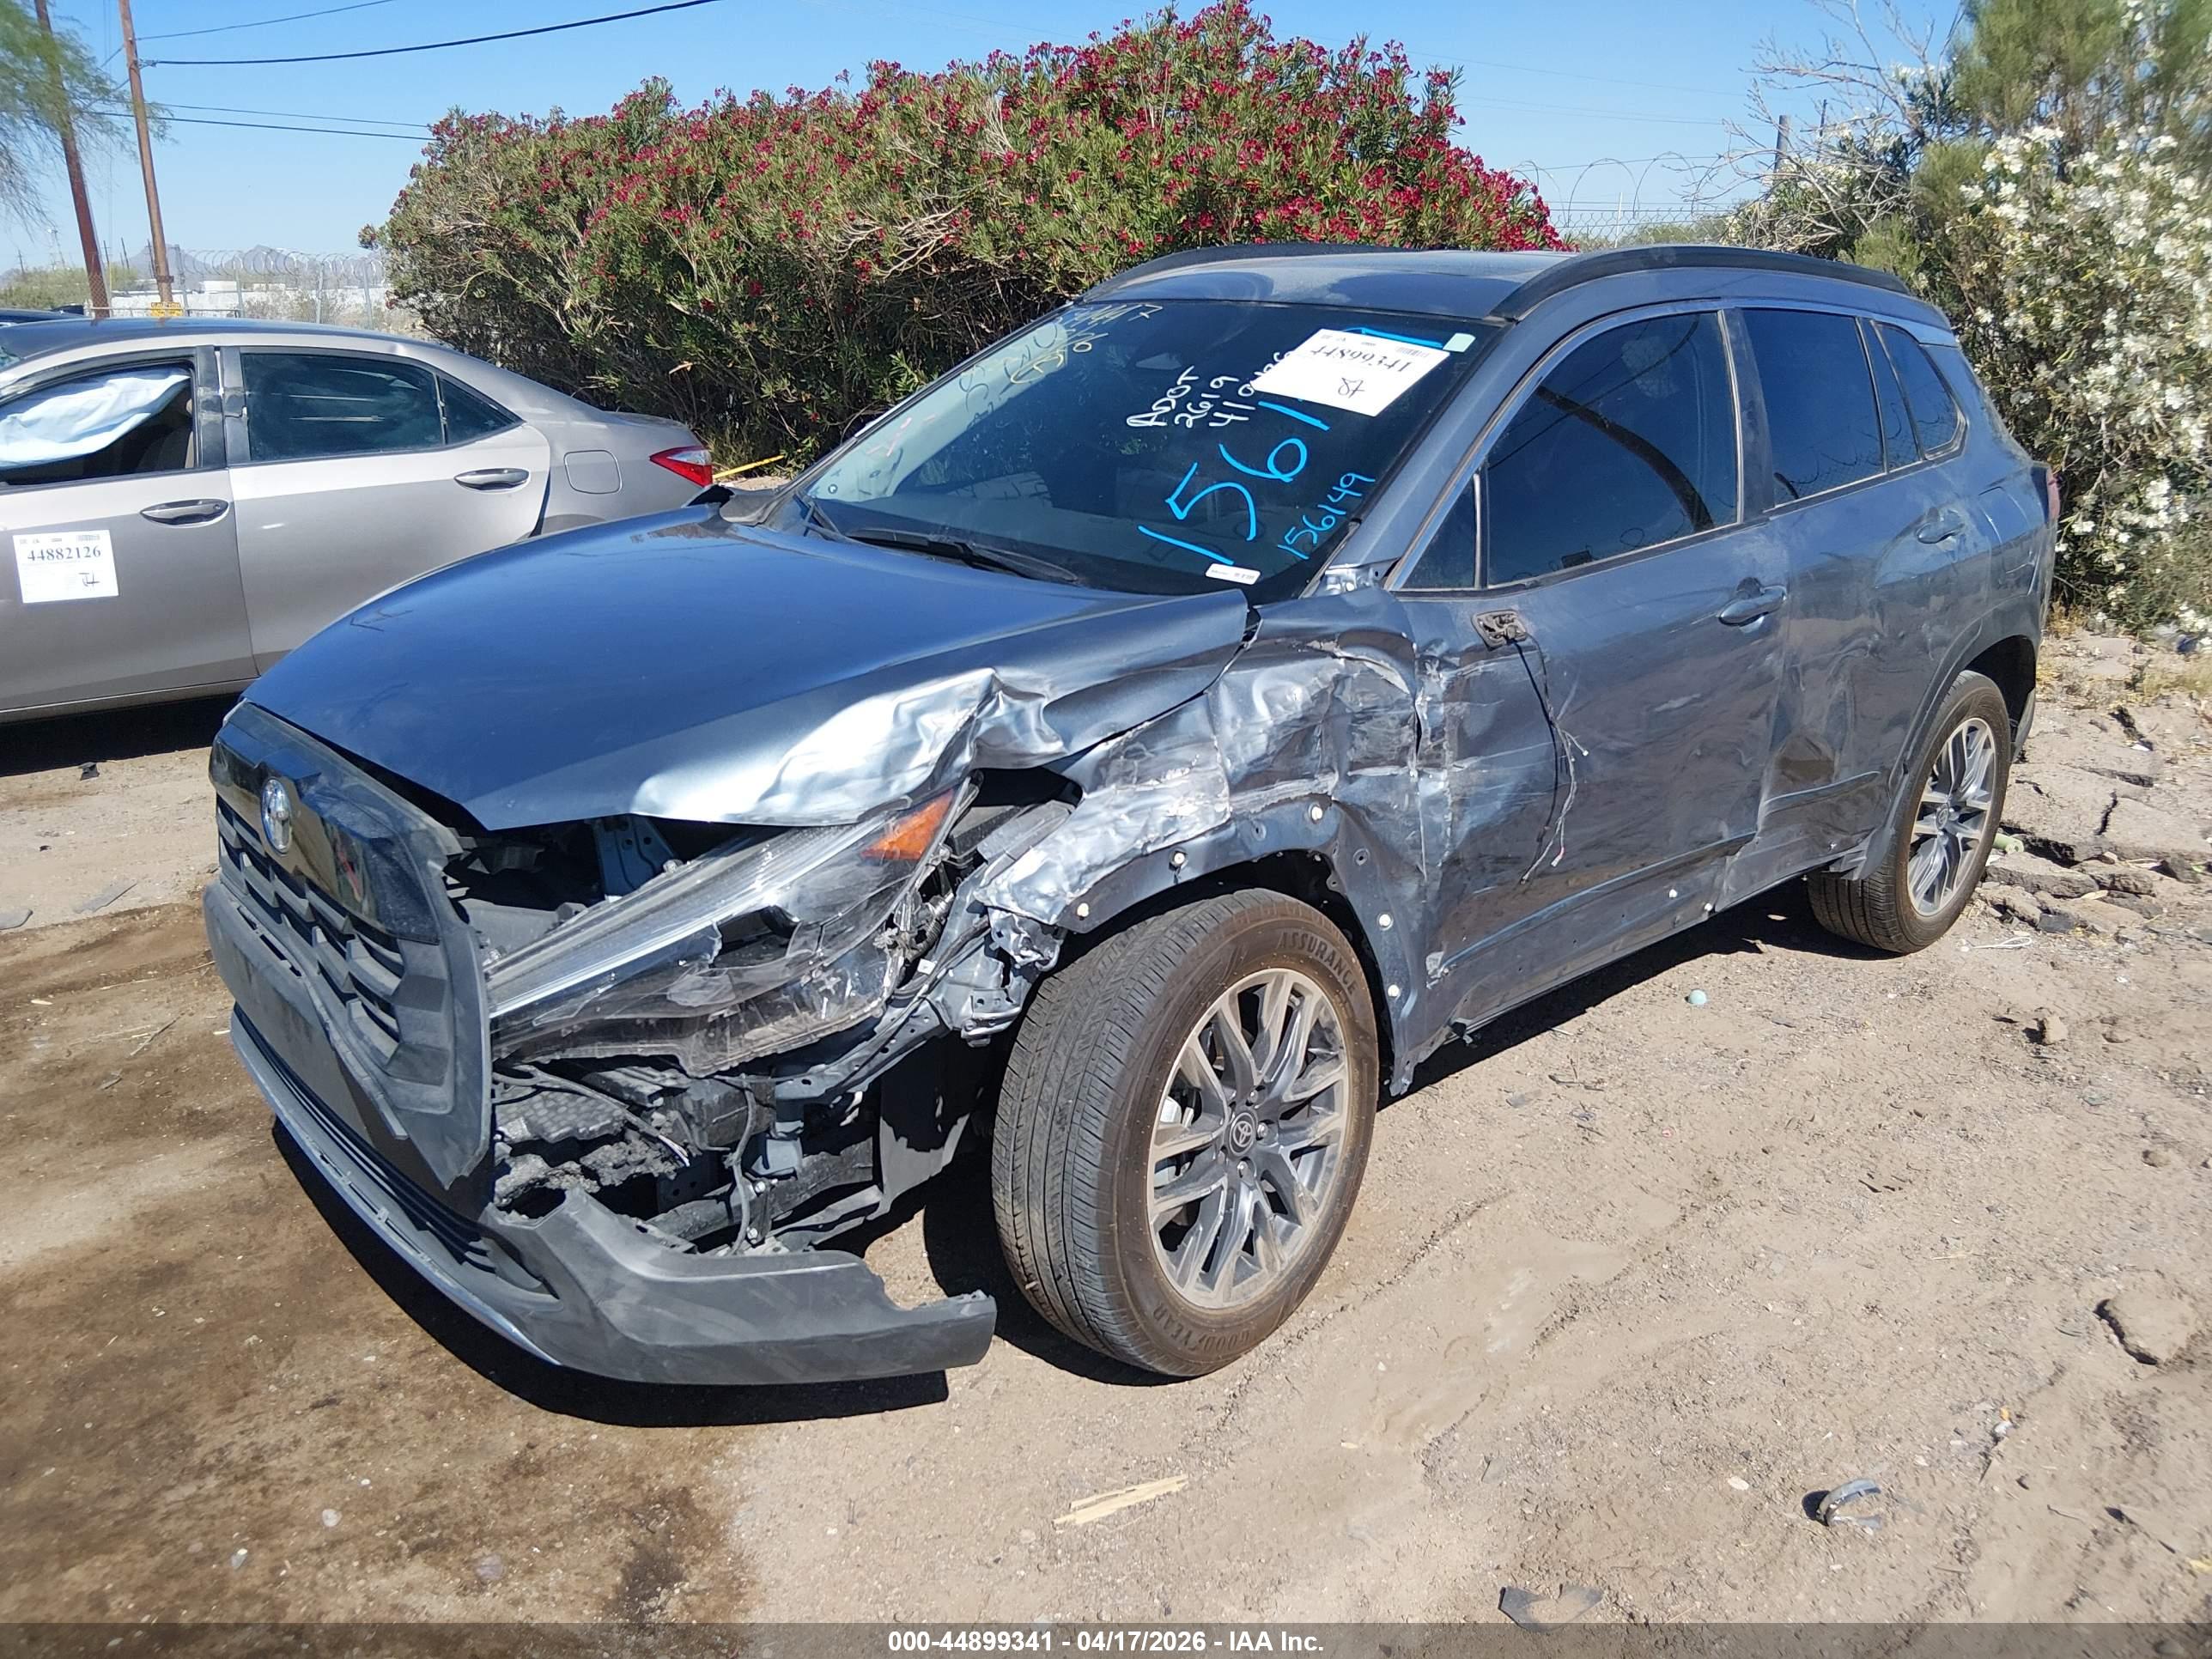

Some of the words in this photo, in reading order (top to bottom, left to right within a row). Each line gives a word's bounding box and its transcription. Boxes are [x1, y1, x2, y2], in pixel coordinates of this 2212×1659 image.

[1310, 345, 1413, 373] 44899341
[1126, 365, 1200, 427] ADOT
[1174, 375, 1240, 428] 2619
[1277, 472, 1376, 560] 156149
[27, 545, 101, 561] 44882126
[1276, 932, 1357, 996] ASSURANCE
